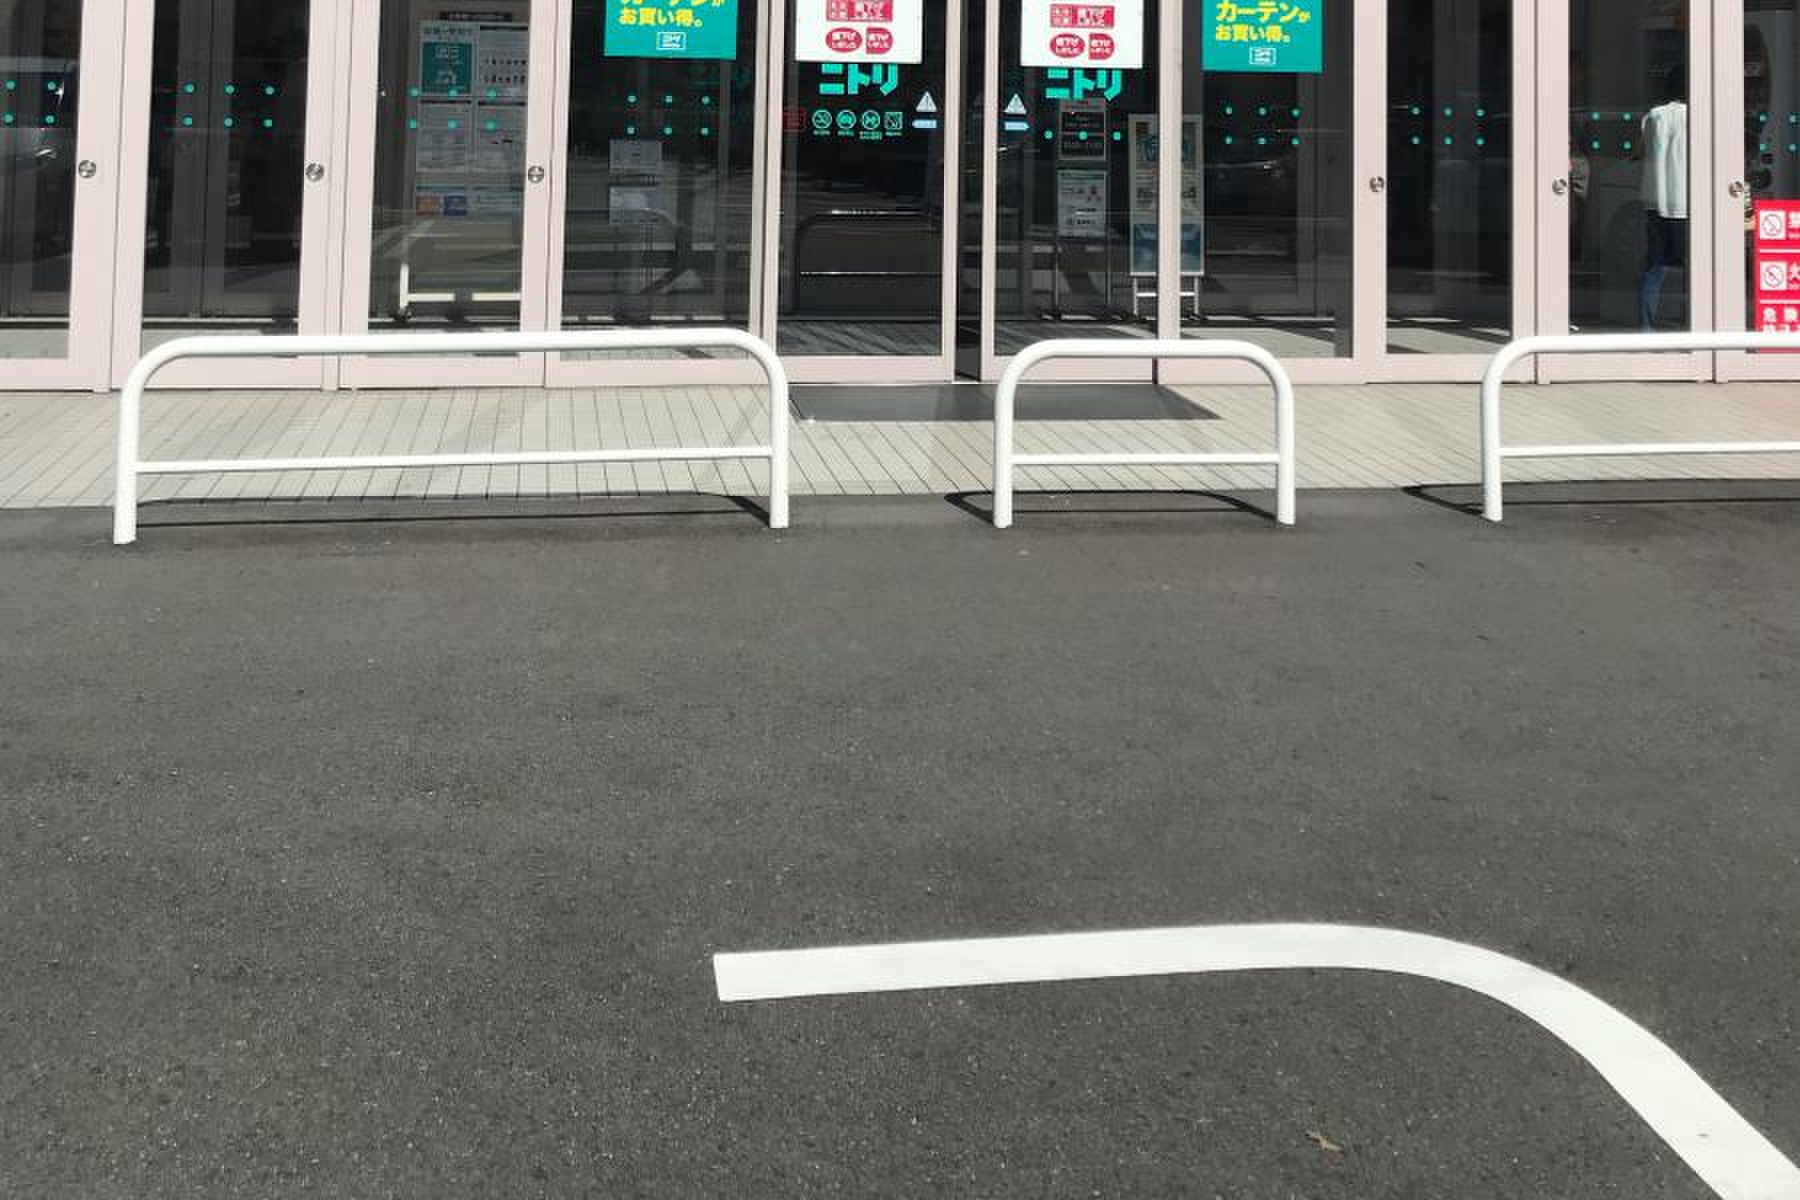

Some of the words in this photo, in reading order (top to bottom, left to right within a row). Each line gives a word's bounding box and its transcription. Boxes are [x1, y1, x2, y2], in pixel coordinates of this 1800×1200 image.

[619, 6, 704, 28] お買い得。
[1215, 0, 1311, 23] カーテンが
[818, 63, 899, 97] ニトリ
[1045, 68, 1122, 101] ニトリ
